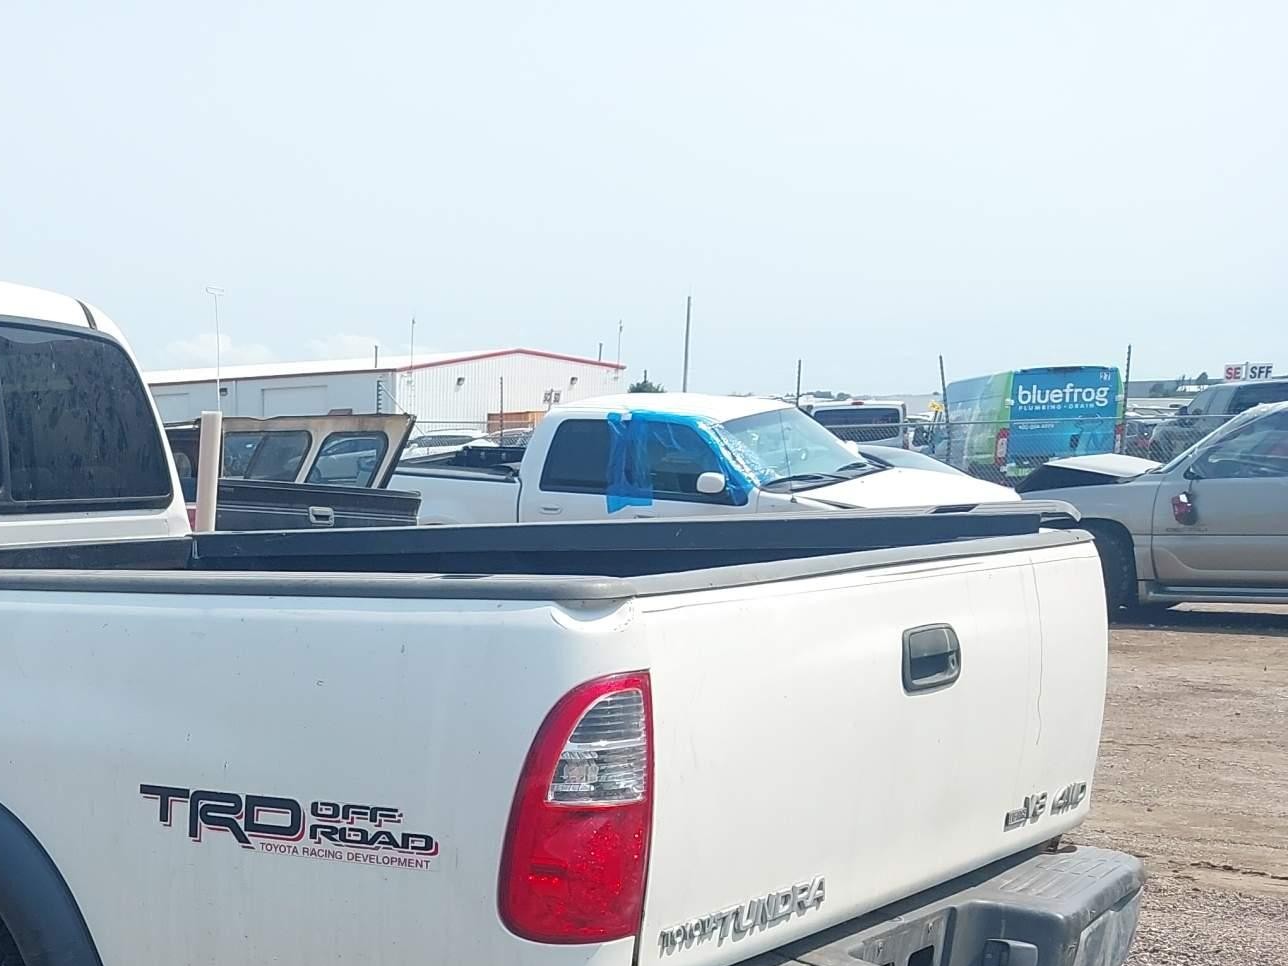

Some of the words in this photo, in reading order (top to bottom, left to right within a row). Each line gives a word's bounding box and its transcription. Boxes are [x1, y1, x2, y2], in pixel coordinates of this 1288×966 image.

[1249, 366, 1272, 379] SFF
[1018, 383, 1109, 407] bluefrog
[139, 783, 306, 850] TRD
[310, 800, 403, 827] OFF
[1024, 792, 1048, 824] V8
[309, 823, 439, 856] ROAD
[259, 841, 299, 856] TOYOTA
[302, 847, 343, 861] RACING
[346, 852, 431, 870] DEVELOPMENT
[715, 875, 826, 946] TUNDRA
